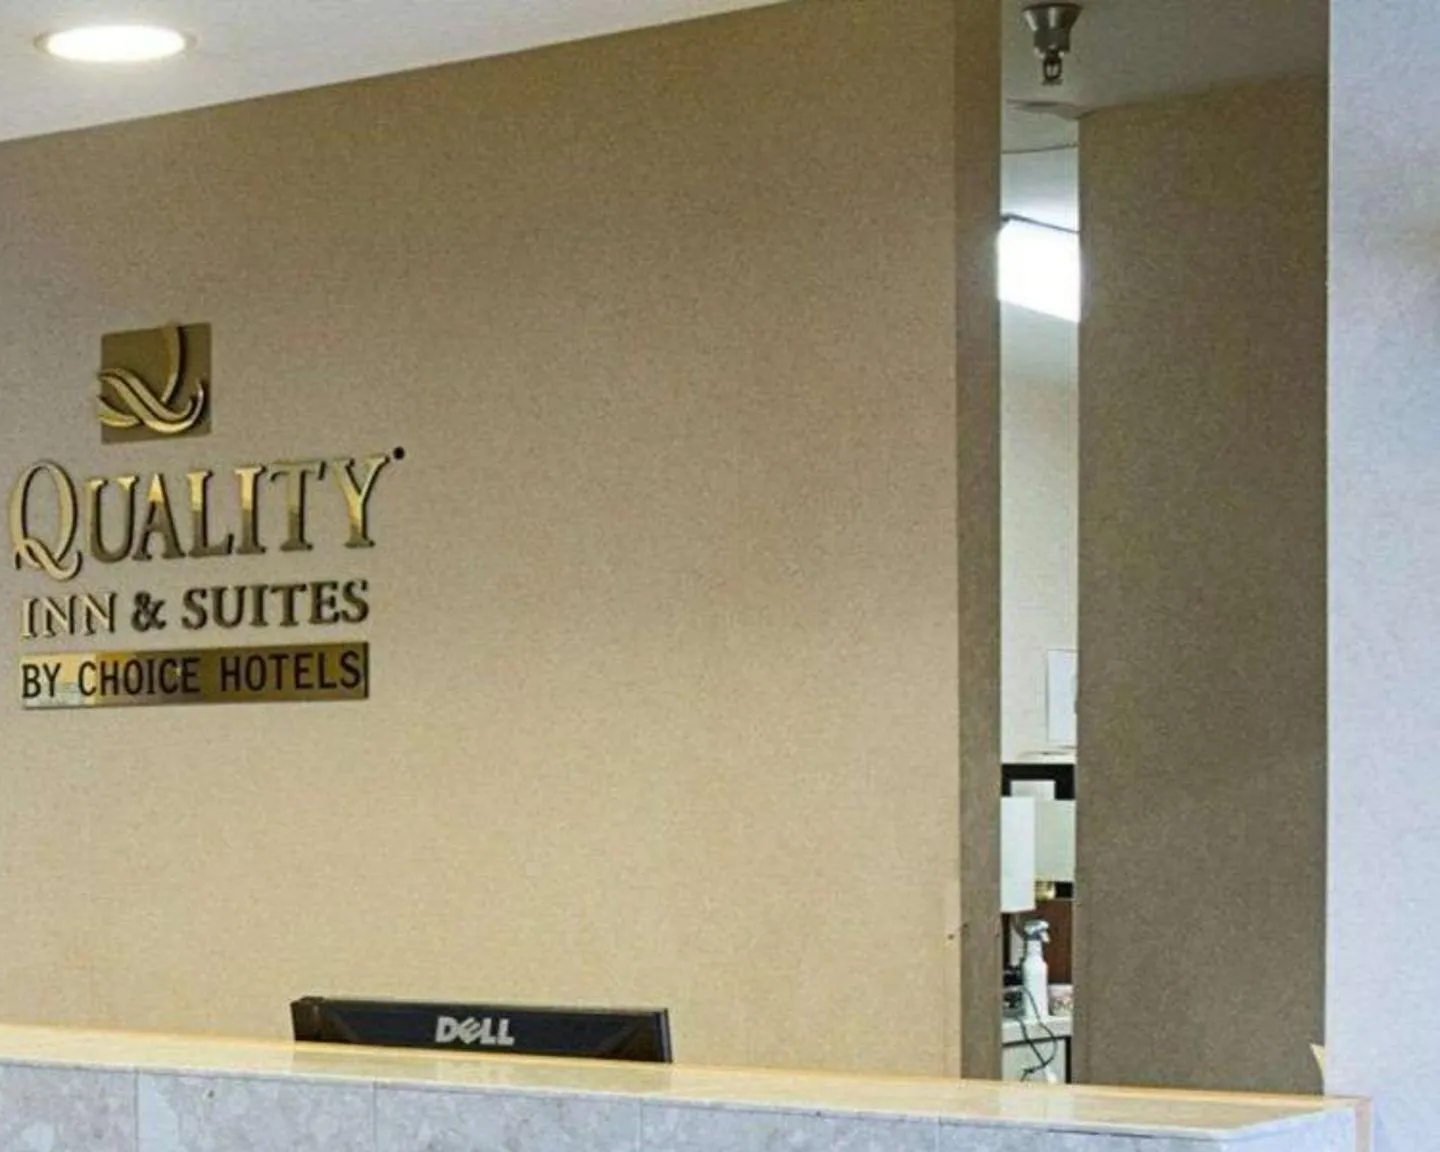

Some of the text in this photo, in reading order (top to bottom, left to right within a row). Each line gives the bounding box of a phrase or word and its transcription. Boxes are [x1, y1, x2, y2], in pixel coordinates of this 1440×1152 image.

[10, 455, 390, 581] QUALITY
[20, 579, 371, 641] INN & SUITES
[21, 649, 363, 700] BY CHOICE HOTELS
[435, 1016, 515, 1046] DELL
